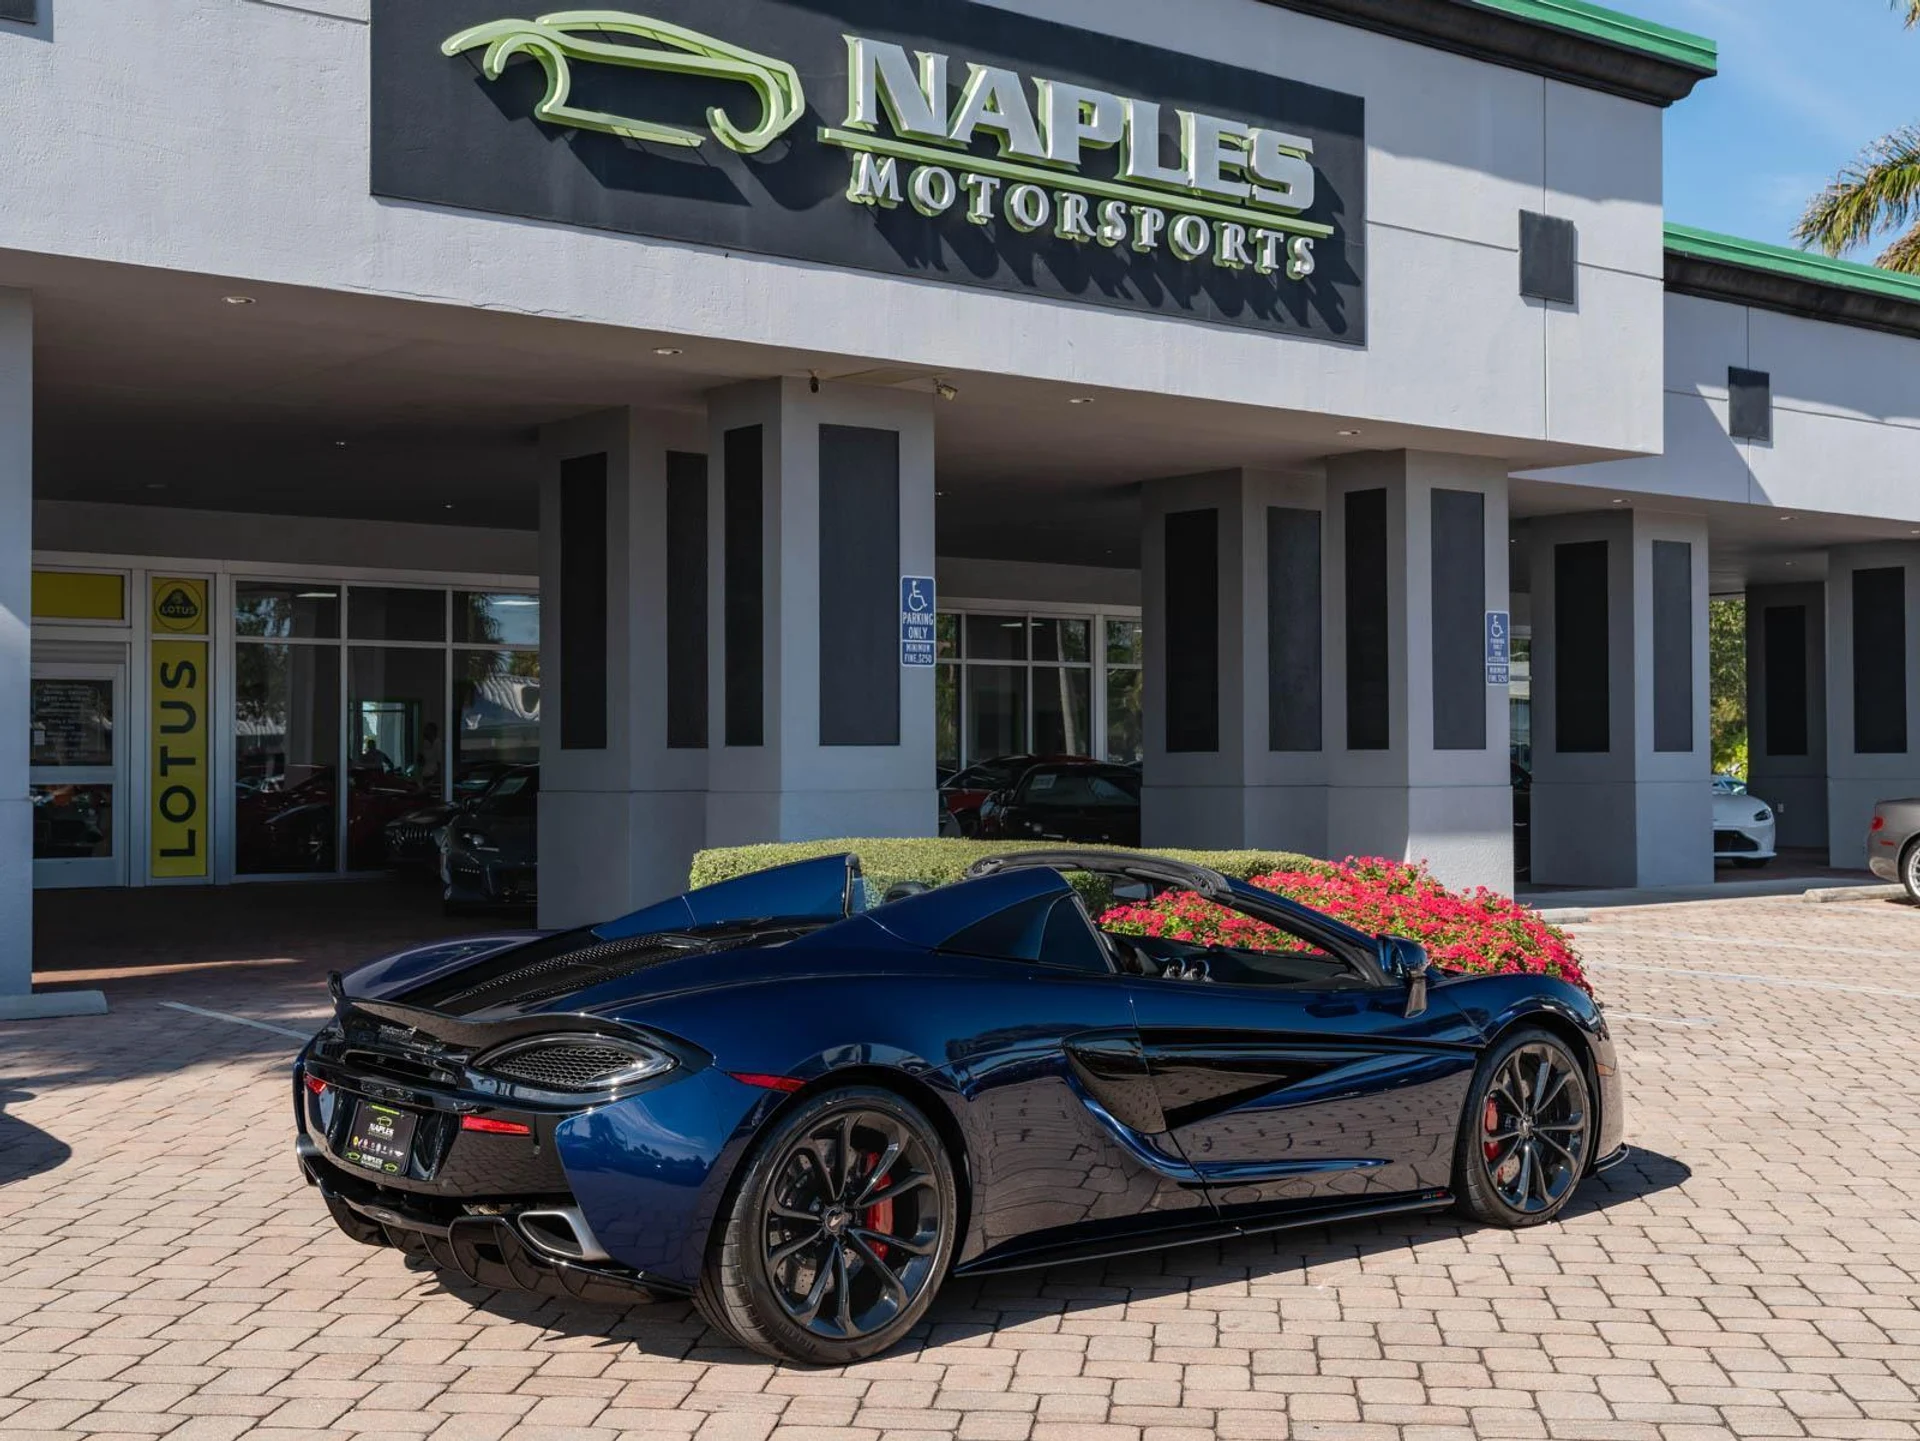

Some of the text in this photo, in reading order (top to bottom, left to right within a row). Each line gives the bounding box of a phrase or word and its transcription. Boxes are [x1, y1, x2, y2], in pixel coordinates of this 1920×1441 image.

[842, 34, 1315, 213] NAPLES
[846, 151, 1315, 280] MOTORSPORTS
[161, 605, 196, 615] LOTUS
[902, 612, 934, 626] PARKING
[908, 626, 928, 639] ONLY
[906, 643, 931, 653] MINIMUM
[159, 660, 197, 858] LOTUS
